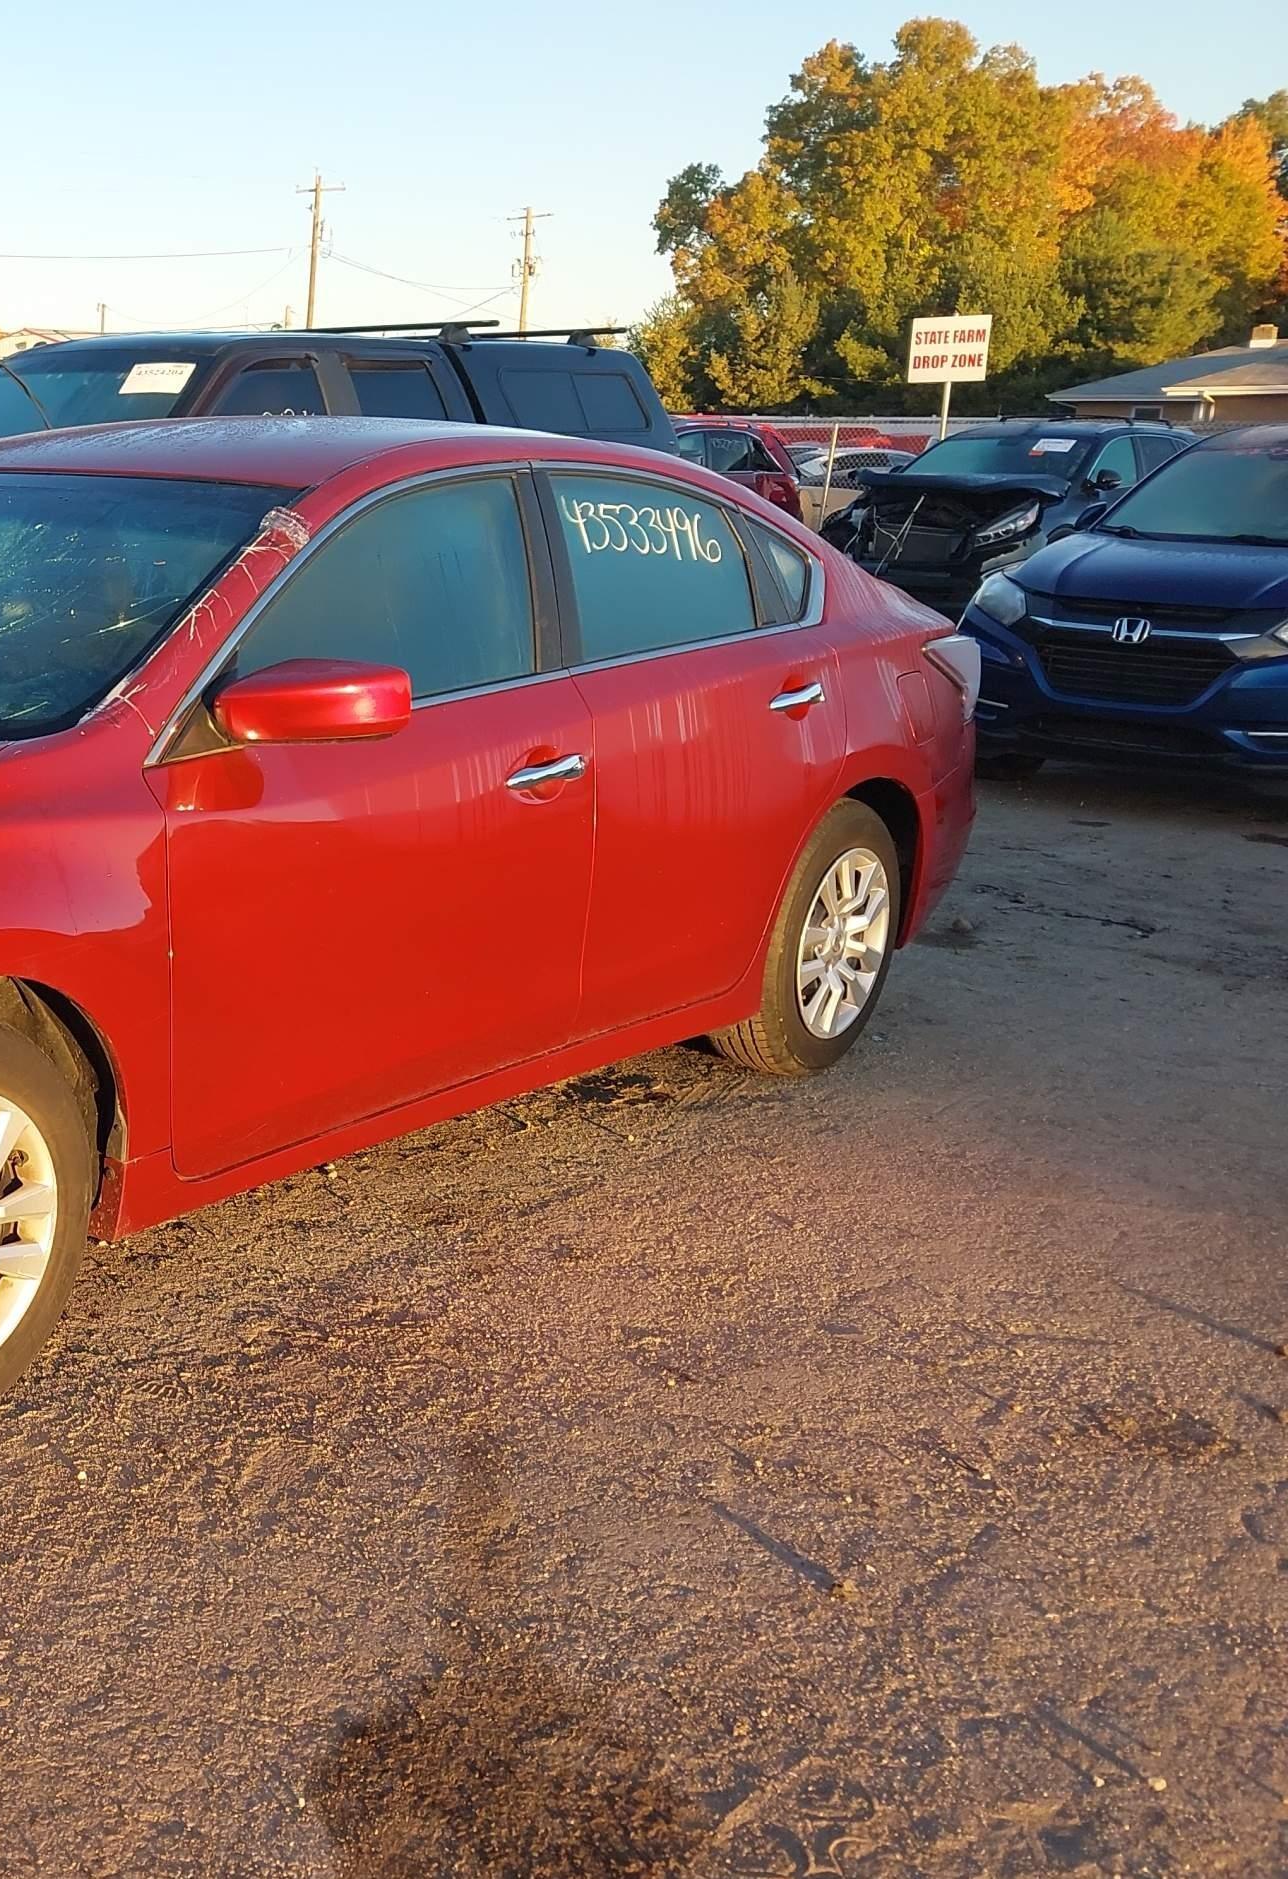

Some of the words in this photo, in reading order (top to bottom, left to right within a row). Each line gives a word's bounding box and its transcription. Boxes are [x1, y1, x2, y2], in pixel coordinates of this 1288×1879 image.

[915, 330, 950, 345] STATE
[953, 329, 987, 344] FARM
[912, 355, 948, 369] DROP
[951, 353, 984, 368] ZONE
[561, 495, 722, 563] 43533496
